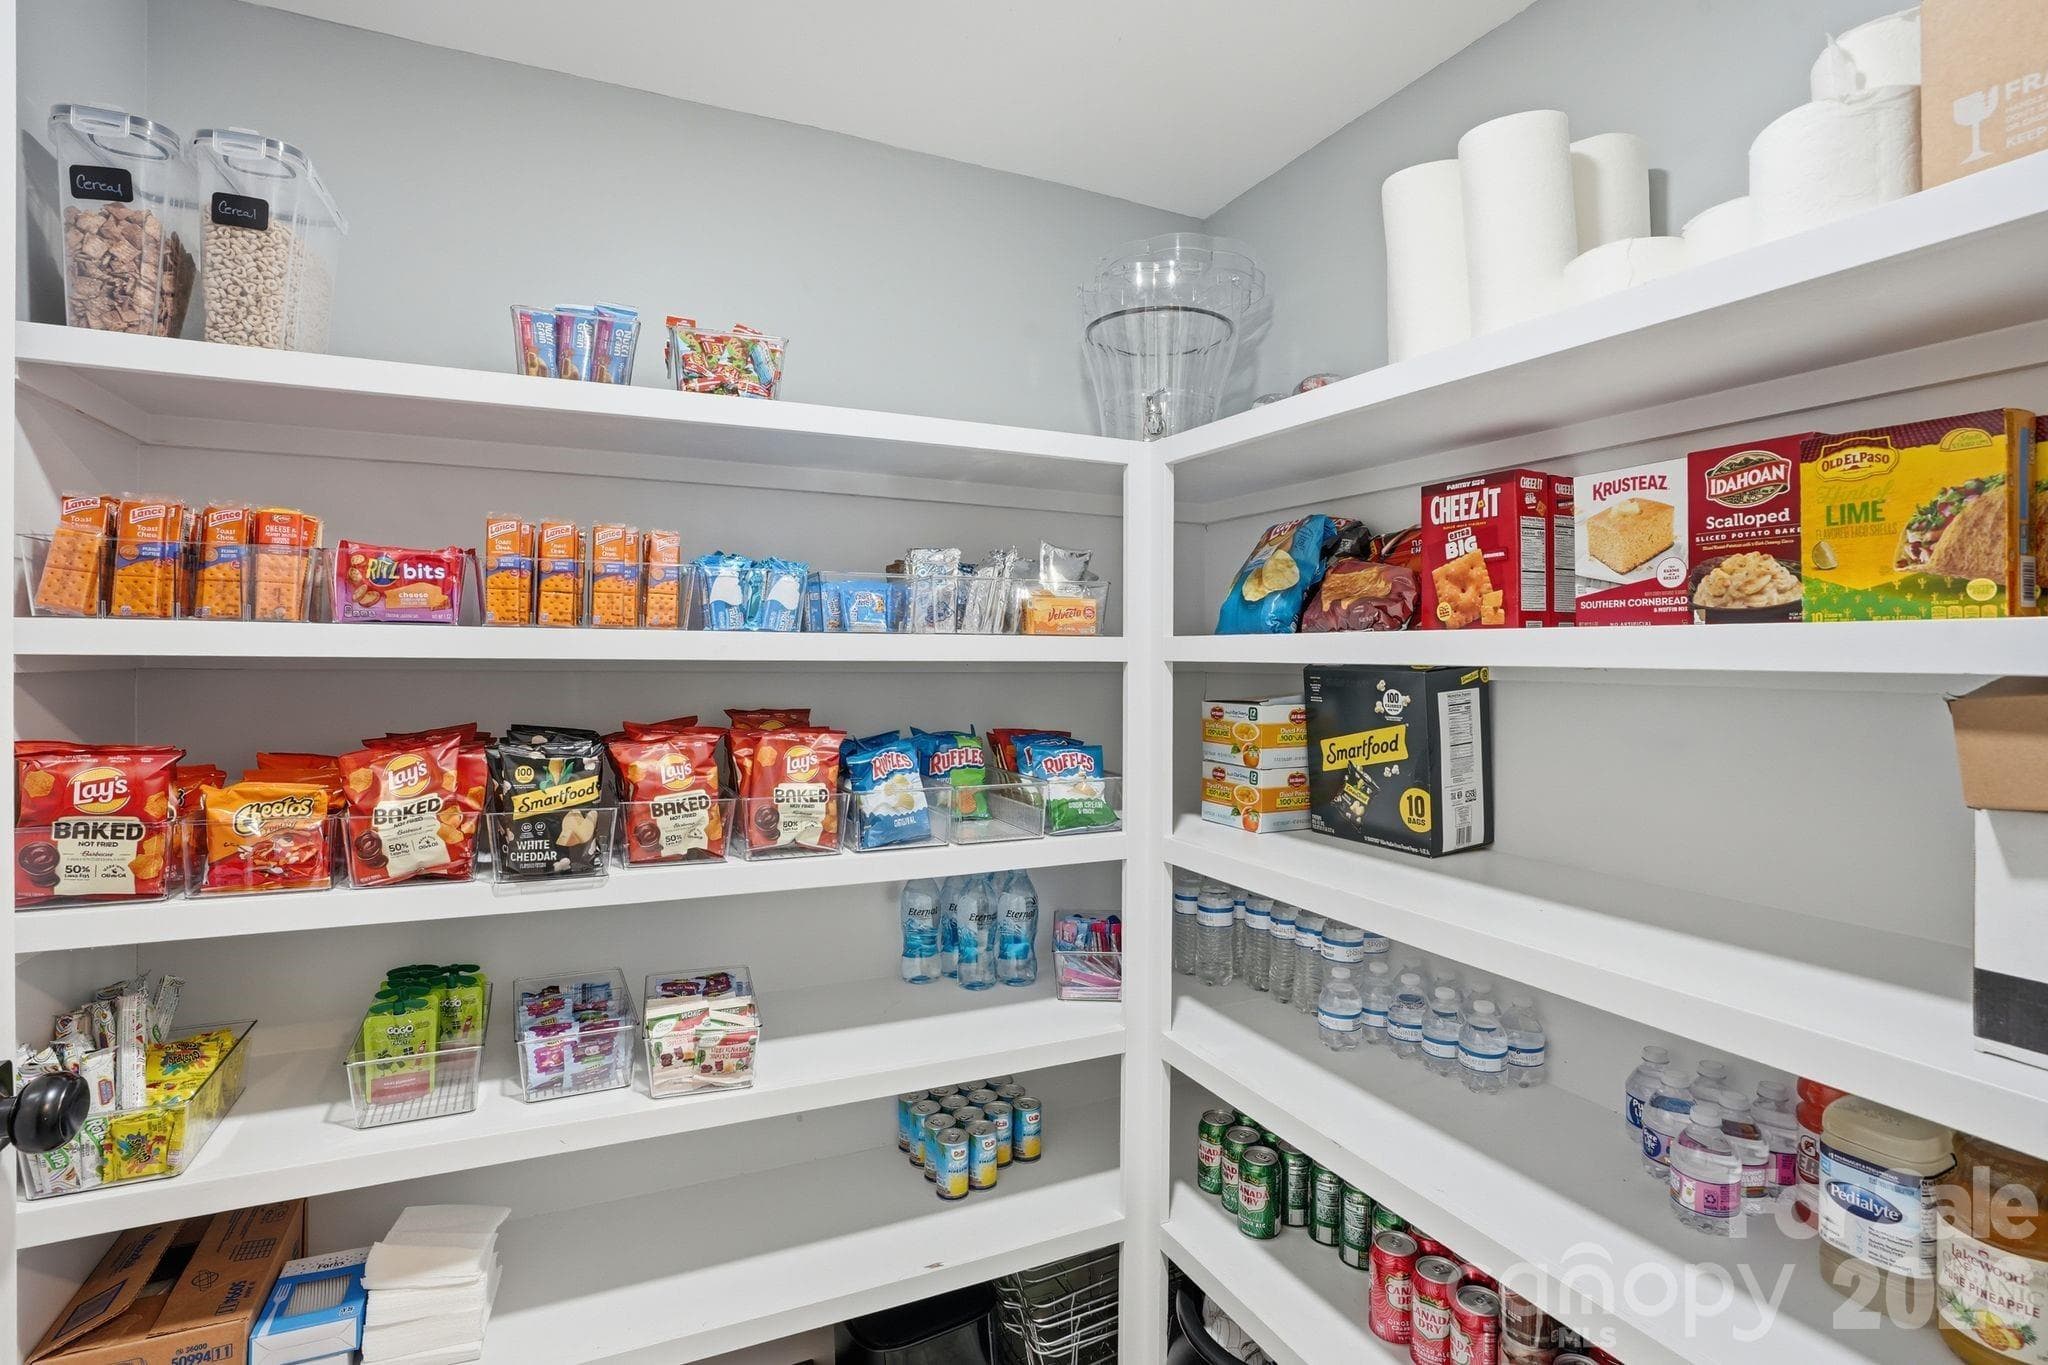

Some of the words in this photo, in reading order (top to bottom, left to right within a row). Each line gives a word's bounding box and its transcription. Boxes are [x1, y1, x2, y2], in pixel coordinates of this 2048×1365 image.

[2005, 72, 2048, 101] FR
[76, 174, 123, 197] Cereal
[218, 201, 257, 220] Cereal
[537, 322, 546, 344] Grain
[614, 329, 624, 356] Grain
[622, 330, 632, 358] Nutri
[1822, 459, 1843, 472] OLD
[1844, 454, 1858, 464] EL
[1593, 475, 1668, 501] KRUSTEAZ
[1711, 464, 1786, 496] IDAHOAN
[65, 499, 98, 511] Lance
[1826, 500, 1886, 527] LIME
[209, 510, 241, 523] Lance
[1706, 507, 1791, 530] Scalloped
[265, 525, 289, 533] CHEESE
[1695, 533, 1727, 543] SLICED
[1731, 529, 1771, 539] POTATO
[1870, 522, 1898, 535] SHELLS
[1445, 536, 1478, 559] BIG
[365, 558, 400, 580] RITZ
[403, 563, 445, 579] bits
[1580, 599, 1626, 609] SOUTHERN
[1628, 596, 1688, 607] CORNBREAD
[1048, 607, 1082, 623] Velveeta
[1811, 612, 1823, 622] 10
[1387, 692, 1400, 704] 100
[1326, 733, 1400, 764] Smartfood
[786, 753, 818, 775] Lay's
[928, 747, 986, 776] RUFFLES
[1042, 752, 1095, 776] RUFFLES
[388, 761, 429, 790] Lay's
[517, 768, 532, 777] 100
[661, 761, 692, 785] Lay's
[74, 776, 129, 806] Lay's
[518, 782, 597, 814] Smartfood
[775, 788, 829, 804] BAKED
[233, 796, 314, 836] Cheetos
[373, 797, 442, 826] BAKED
[651, 795, 711, 818] BAKED
[1406, 794, 1426, 818] 10
[54, 821, 145, 841] BAKED
[1407, 816, 1426, 826] BAGS
[389, 842, 409, 852] 50%
[516, 839, 551, 850] WHITE
[665, 834, 683, 843] 50%
[510, 850, 558, 862] CHEDDAR
[65, 864, 91, 874] 50%
[908, 906, 938, 917] Eternal
[1239, 1185, 1269, 1200] ANADA
[1241, 1194, 1259, 1206] DRY
[1831, 1183, 1900, 1221] Pedialyte
[317, 1259, 345, 1270] Forks
[1969, 1282, 2041, 1319] PINEAPPLE
[1419, 1319, 1442, 1335] DRY
[172, 1351, 212, 1365] 50994
